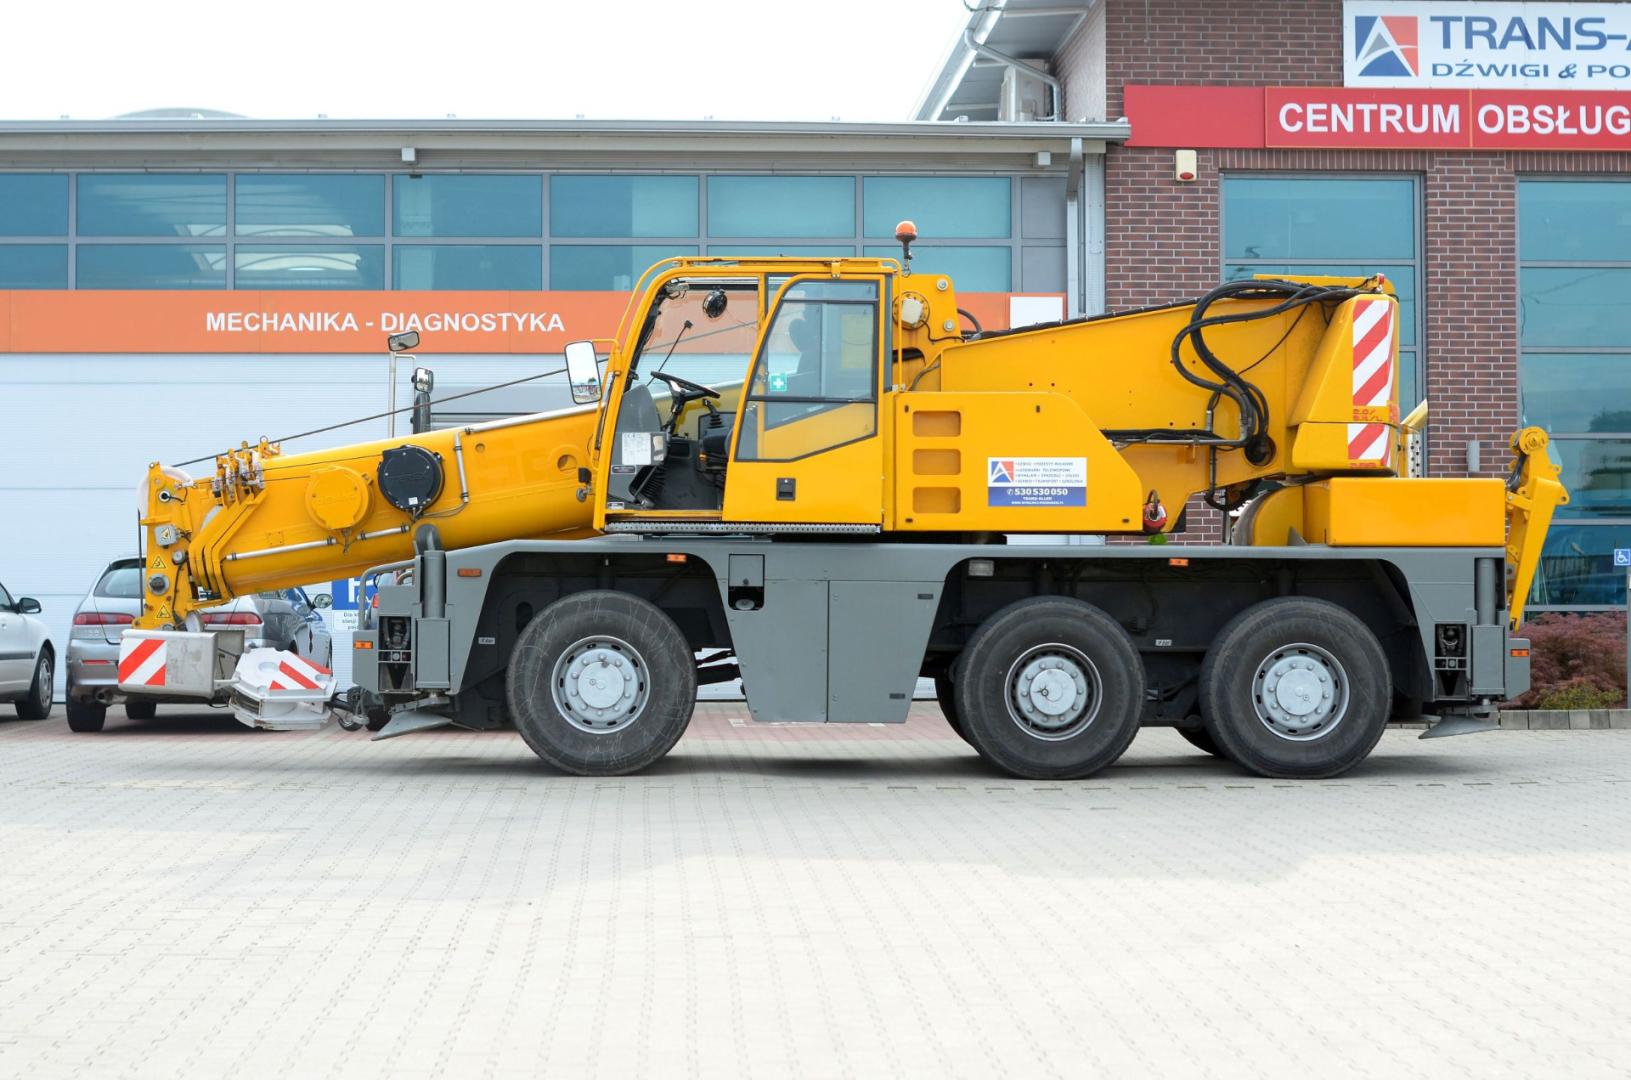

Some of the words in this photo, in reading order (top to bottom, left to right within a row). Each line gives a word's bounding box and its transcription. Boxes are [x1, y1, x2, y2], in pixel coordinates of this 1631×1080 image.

[1430, 16, 1631, 50] TRANS-
[1432, 59, 1549, 78] DŹWIGI
[1558, 63, 1577, 79] &
[1278, 103, 1460, 134] CENTRUM
[1477, 104, 1631, 135] OBSŁUG
[206, 312, 359, 332] MECHANIKA
[380, 312, 565, 332] DIAGNOSTYKA
